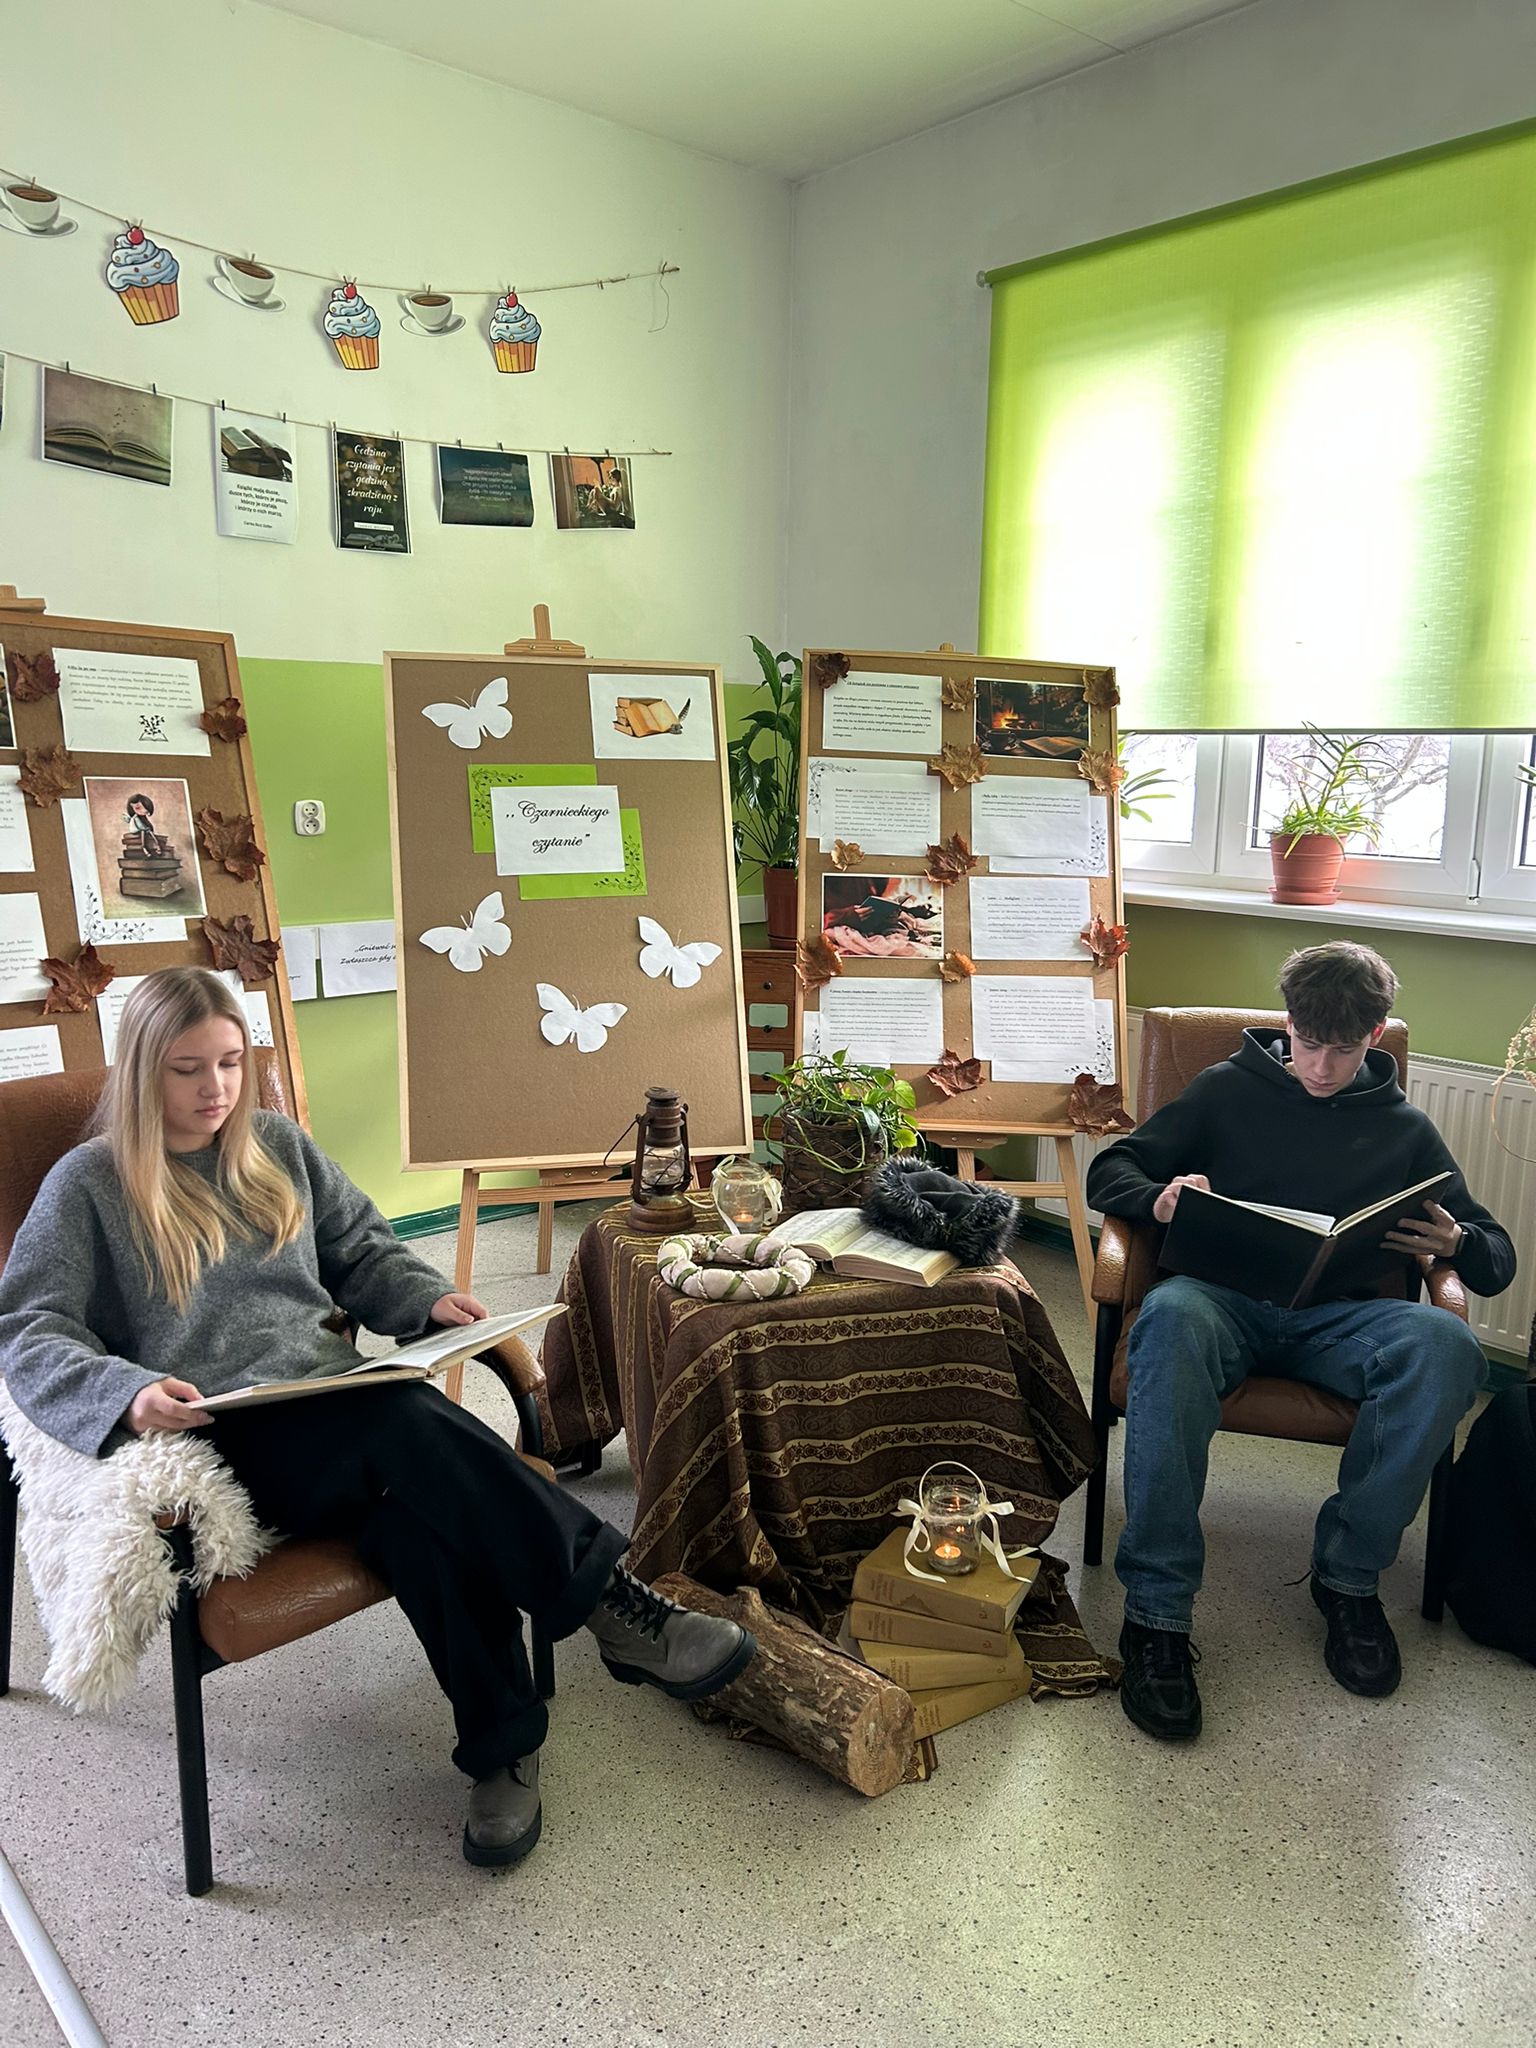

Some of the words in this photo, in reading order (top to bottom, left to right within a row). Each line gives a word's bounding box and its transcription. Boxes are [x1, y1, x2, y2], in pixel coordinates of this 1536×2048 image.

[354, 444, 387, 458] Godzina
[345, 460, 381, 473] czytania
[381, 463, 396, 476] jest
[393, 494, 398, 502] z
